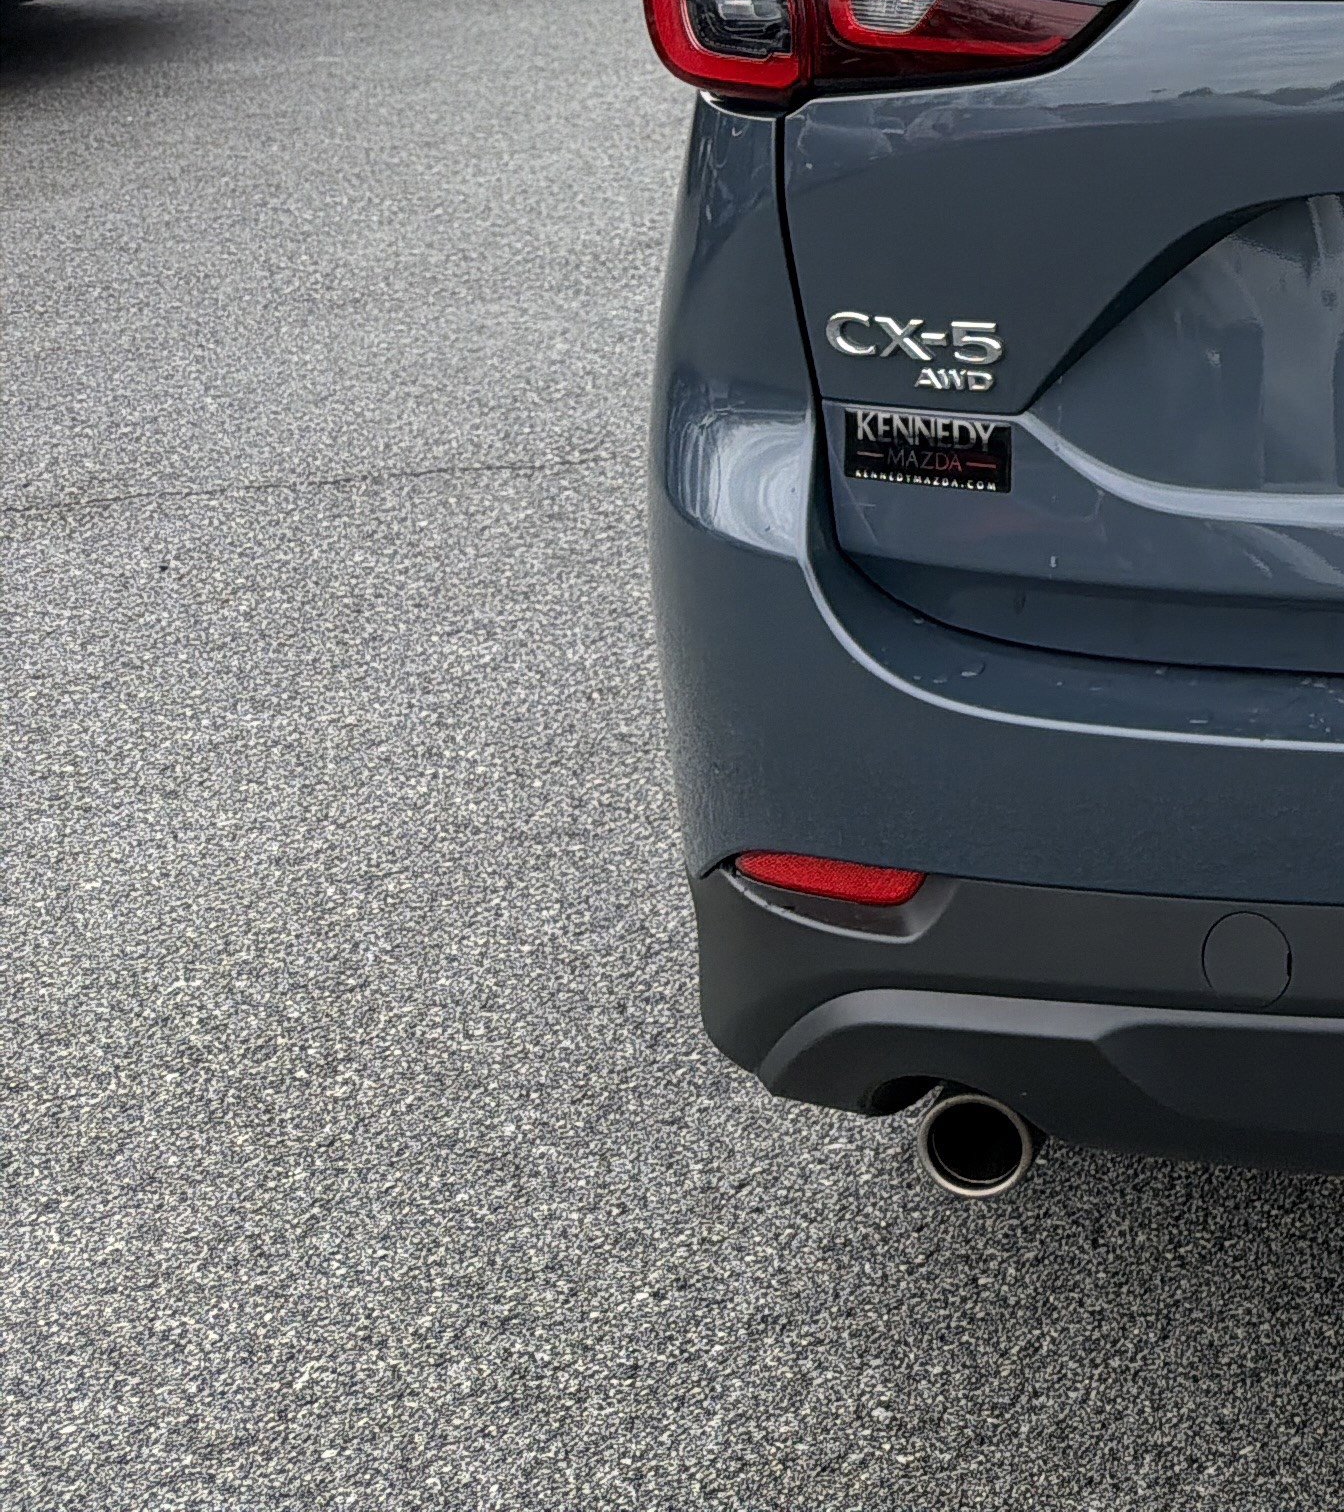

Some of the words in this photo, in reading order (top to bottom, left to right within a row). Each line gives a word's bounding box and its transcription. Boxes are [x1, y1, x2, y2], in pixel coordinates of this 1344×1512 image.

[826, 311, 1003, 365] CX-5
[914, 367, 994, 391] AWD
[856, 410, 997, 452] KENNEDY
[887, 448, 963, 473] MAZDA
